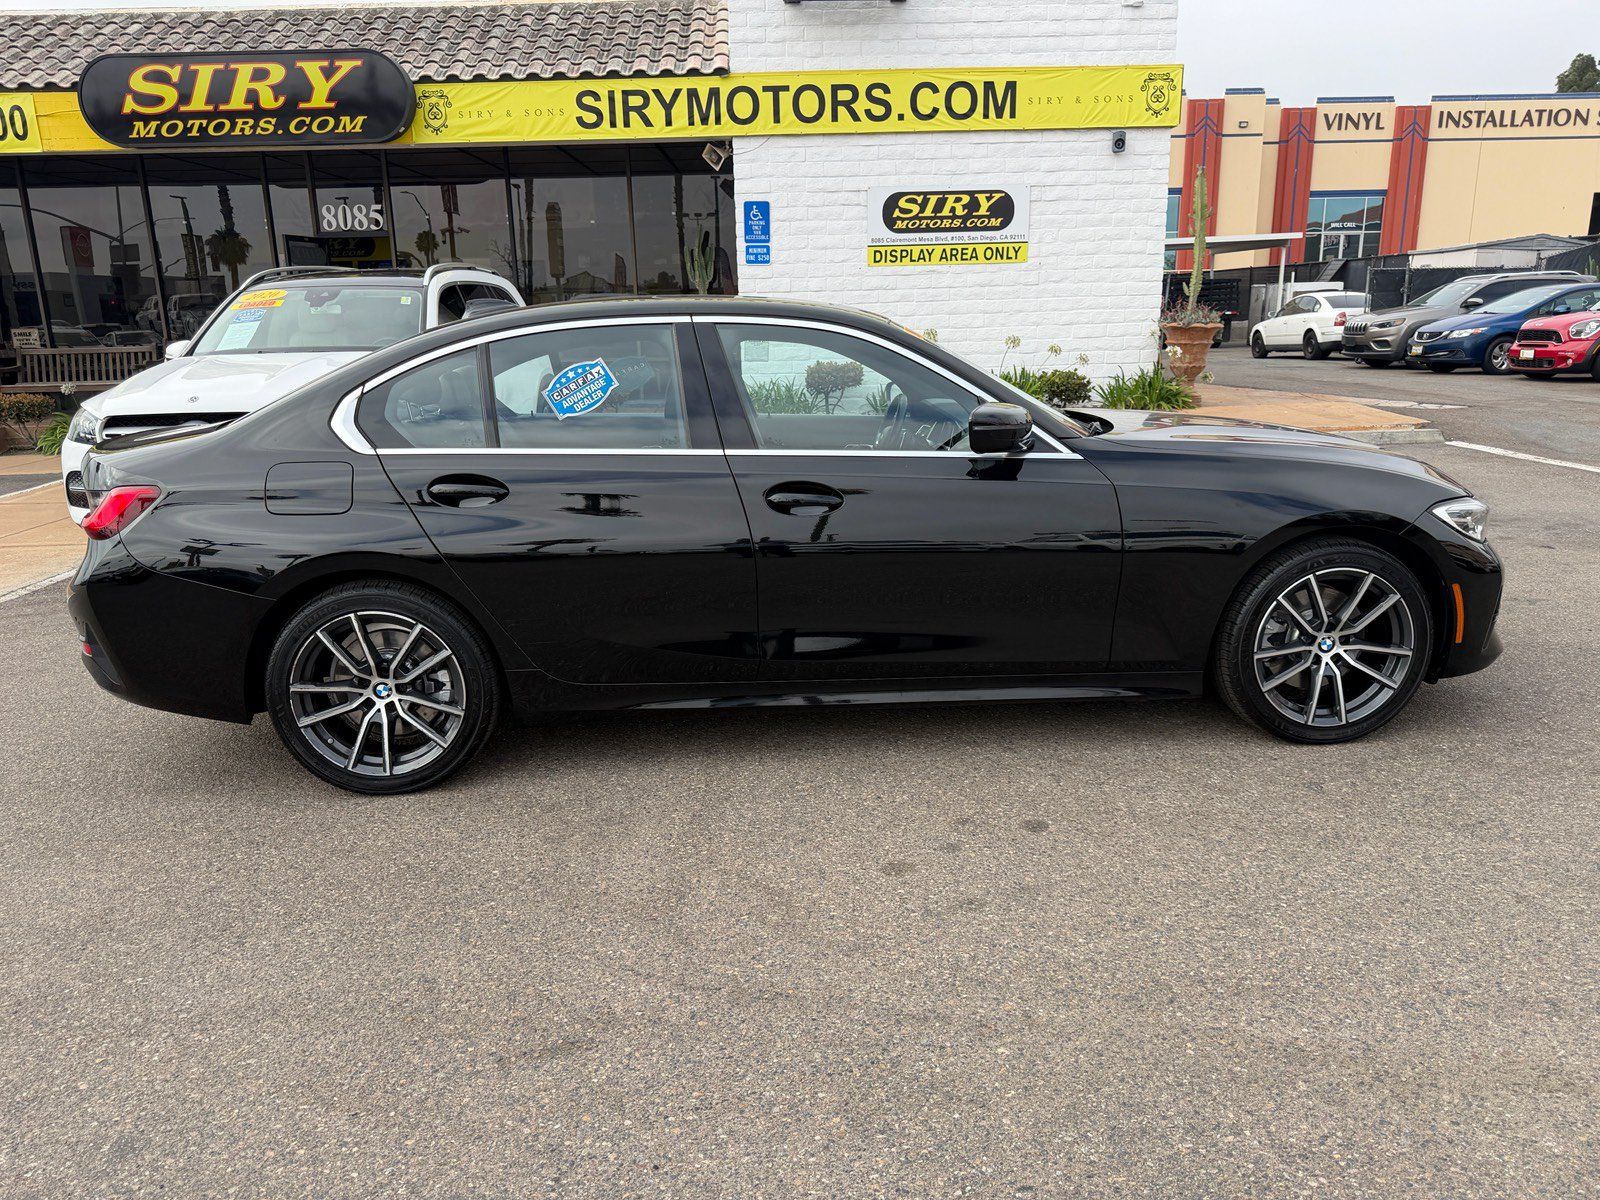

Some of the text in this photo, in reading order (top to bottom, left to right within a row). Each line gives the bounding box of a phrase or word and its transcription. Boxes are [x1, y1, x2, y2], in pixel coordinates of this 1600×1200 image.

[121, 58, 364, 115] SIRY
[574, 80, 1018, 129] SIRYMOTORS.COM
[1027, 94, 1135, 106] SIRY & SONS
[458, 108, 565, 119] SIRY & SONS
[1323, 112, 1385, 131] VINYL
[1437, 108, 1590, 128] INSTALLATION
[128, 115, 368, 139] MOTORS.COM
[892, 192, 1005, 218] SIRY
[321, 204, 384, 231] 8085
[892, 218, 1004, 229] MOTORS.COM
[873, 246, 1022, 264] DISPLAY AREA ONLY
[551, 366, 604, 402] CARFAX
[562, 377, 607, 409] ADVANTAGE
[573, 390, 604, 412] DEALER
